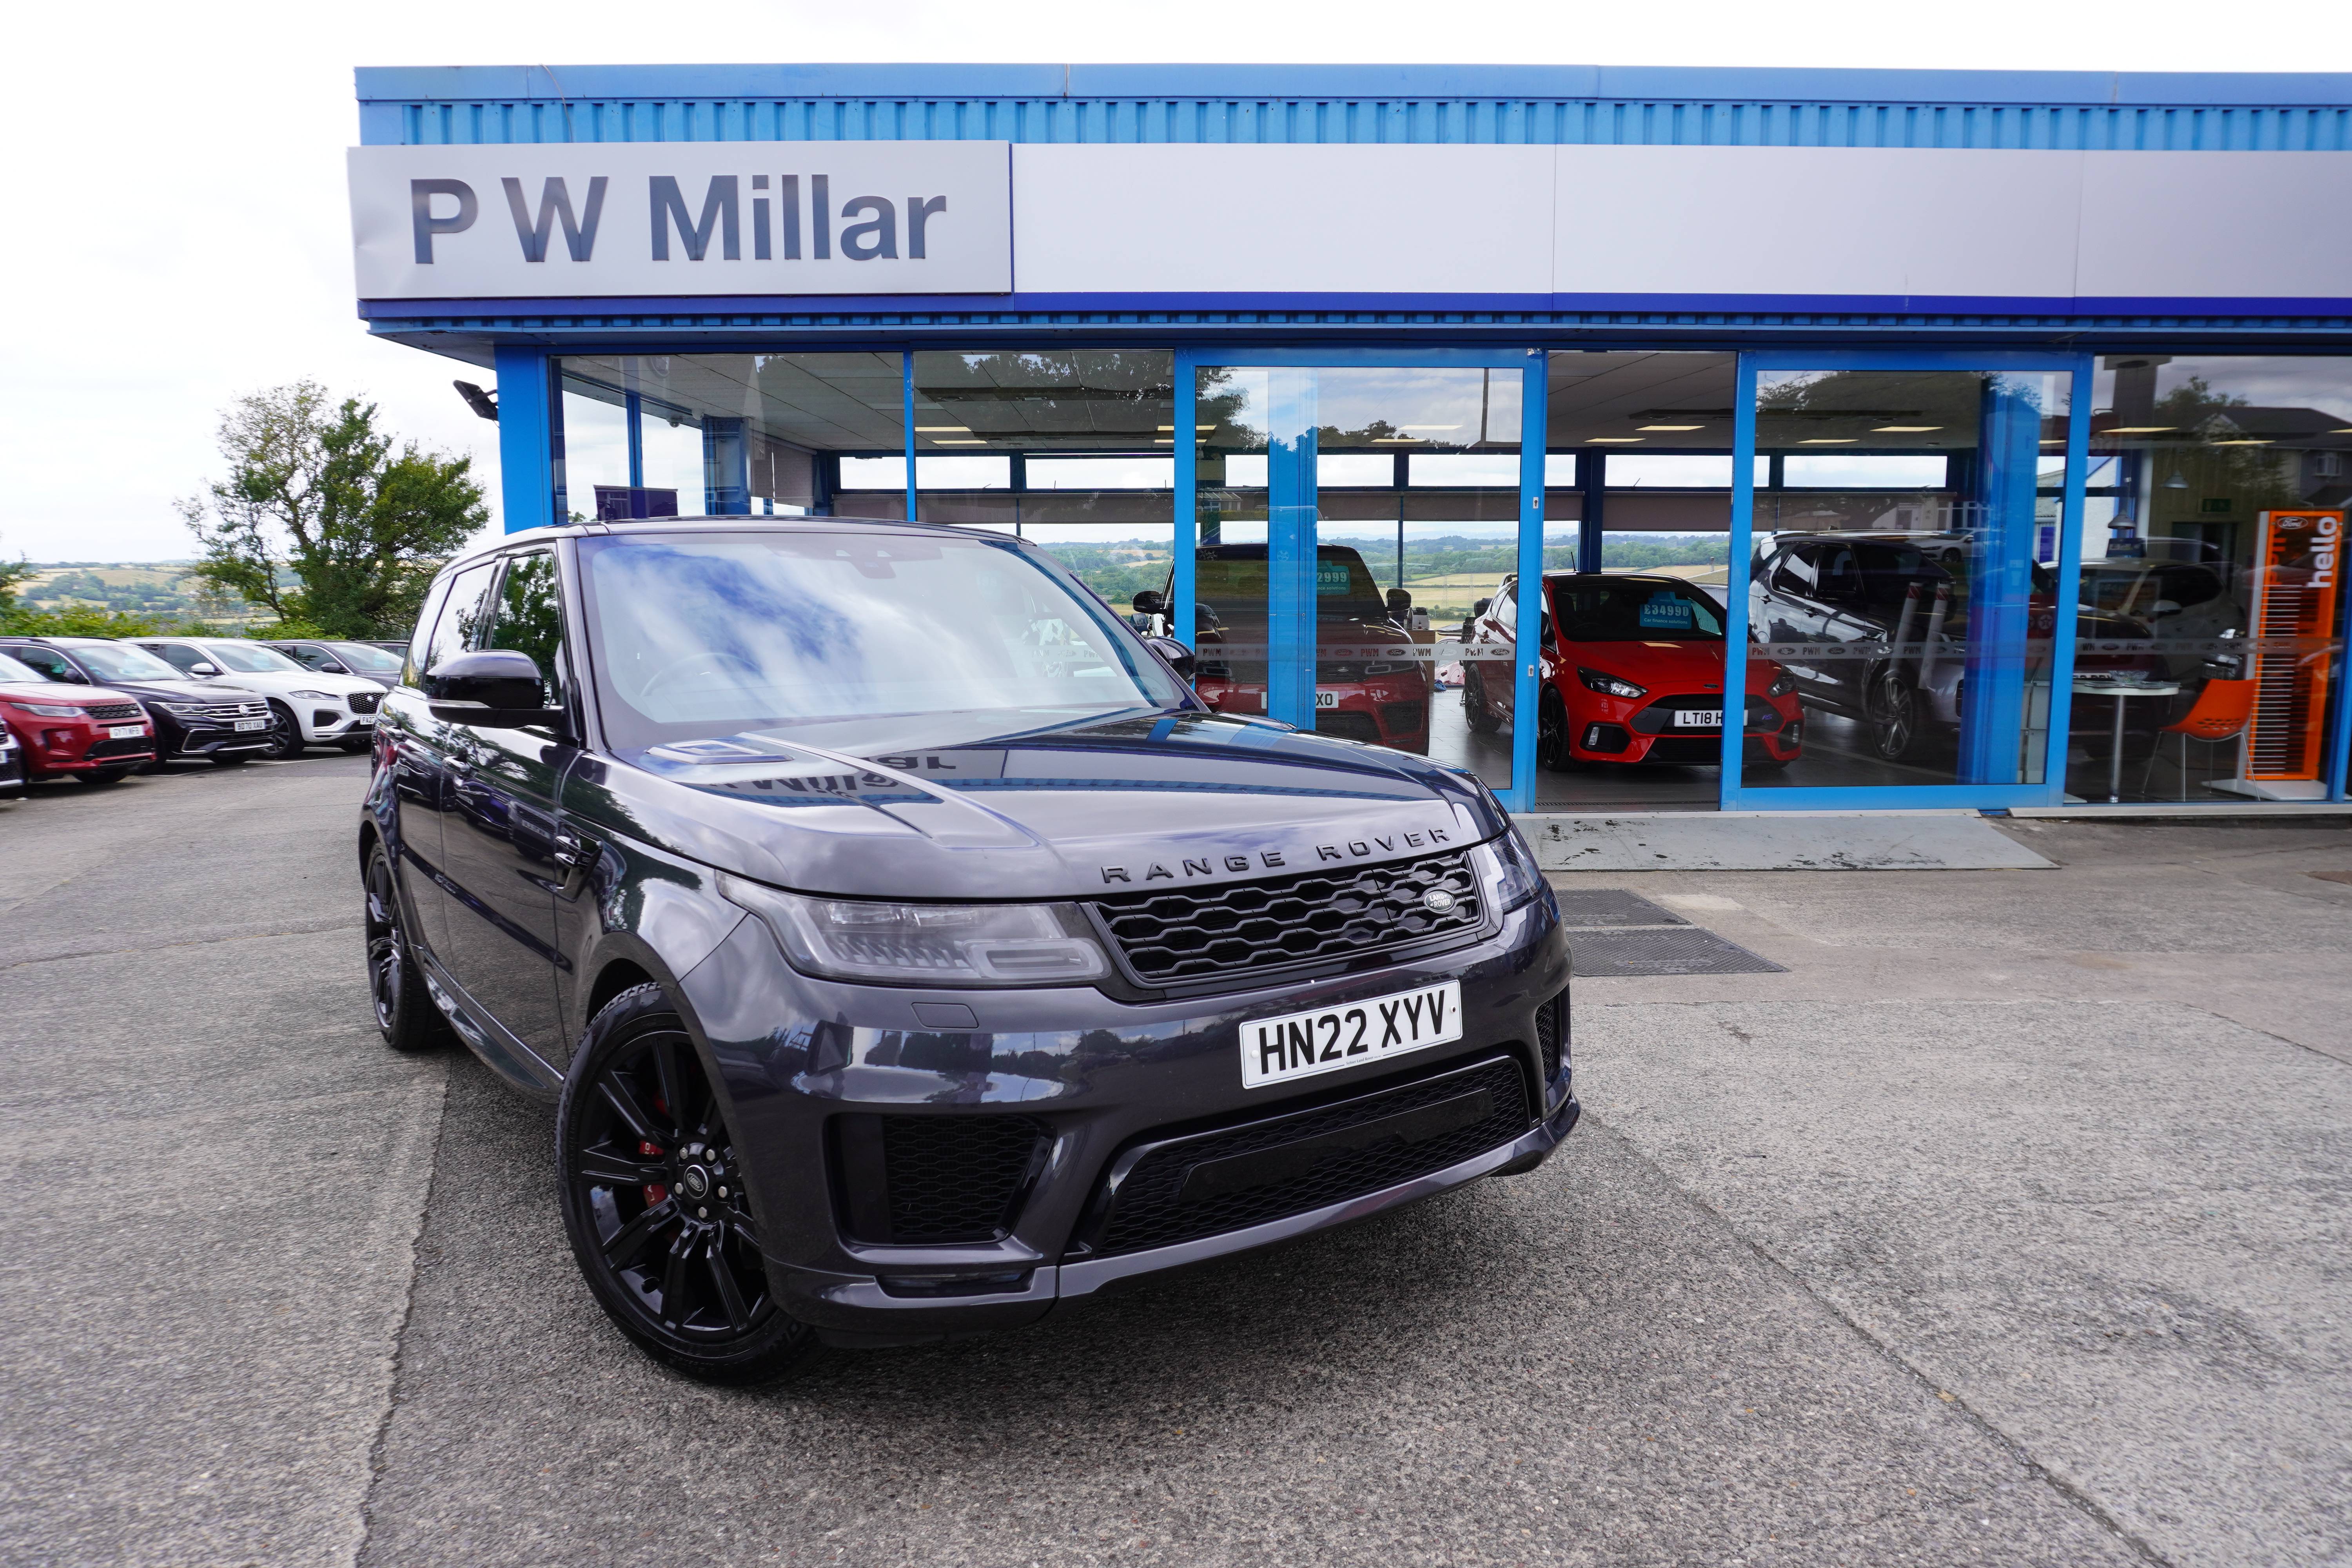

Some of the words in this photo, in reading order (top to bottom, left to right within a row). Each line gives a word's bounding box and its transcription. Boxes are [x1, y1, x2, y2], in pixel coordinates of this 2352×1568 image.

[410, 179, 478, 265] P
[501, 176, 608, 263] W
[649, 174, 947, 262] Millar
[2307, 517, 2337, 588] hello
[1683, 712, 1712, 724] LT18
[1100, 849, 1286, 884] RANGE
[1316, 827, 1451, 860] ROVER
[1429, 893, 1445, 902] LAND
[1433, 898, 1451, 908] ROVER
[1259, 1008, 1369, 1075] HN22
[1379, 989, 1445, 1048] XYV
